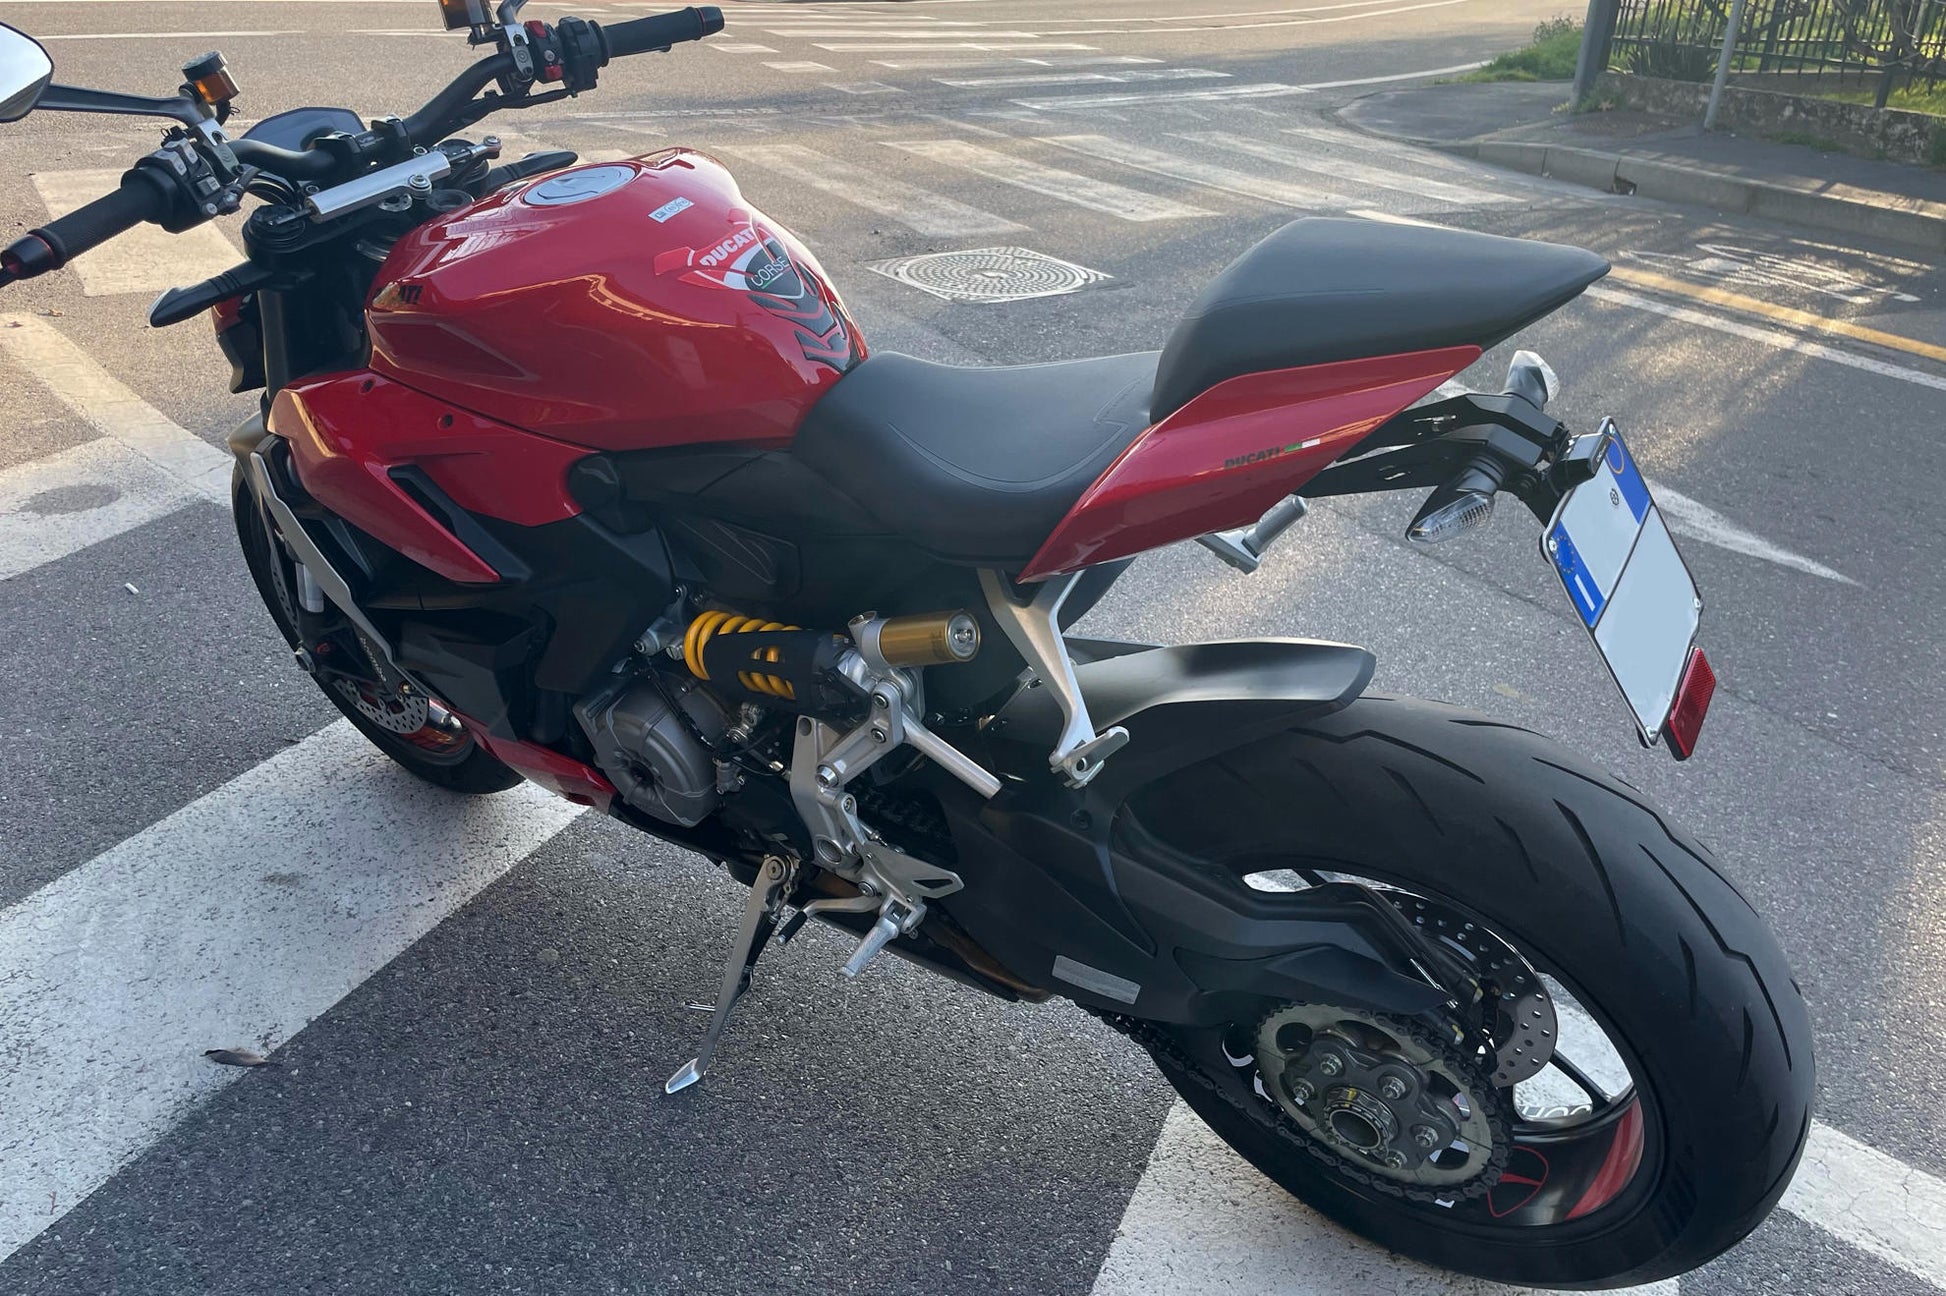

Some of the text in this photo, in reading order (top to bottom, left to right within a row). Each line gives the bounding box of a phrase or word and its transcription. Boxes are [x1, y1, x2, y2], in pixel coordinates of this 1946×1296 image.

[699, 227, 756, 267] DUCAT
[750, 256, 790, 287] CORSE
[1223, 447, 1281, 470] DUCATI
